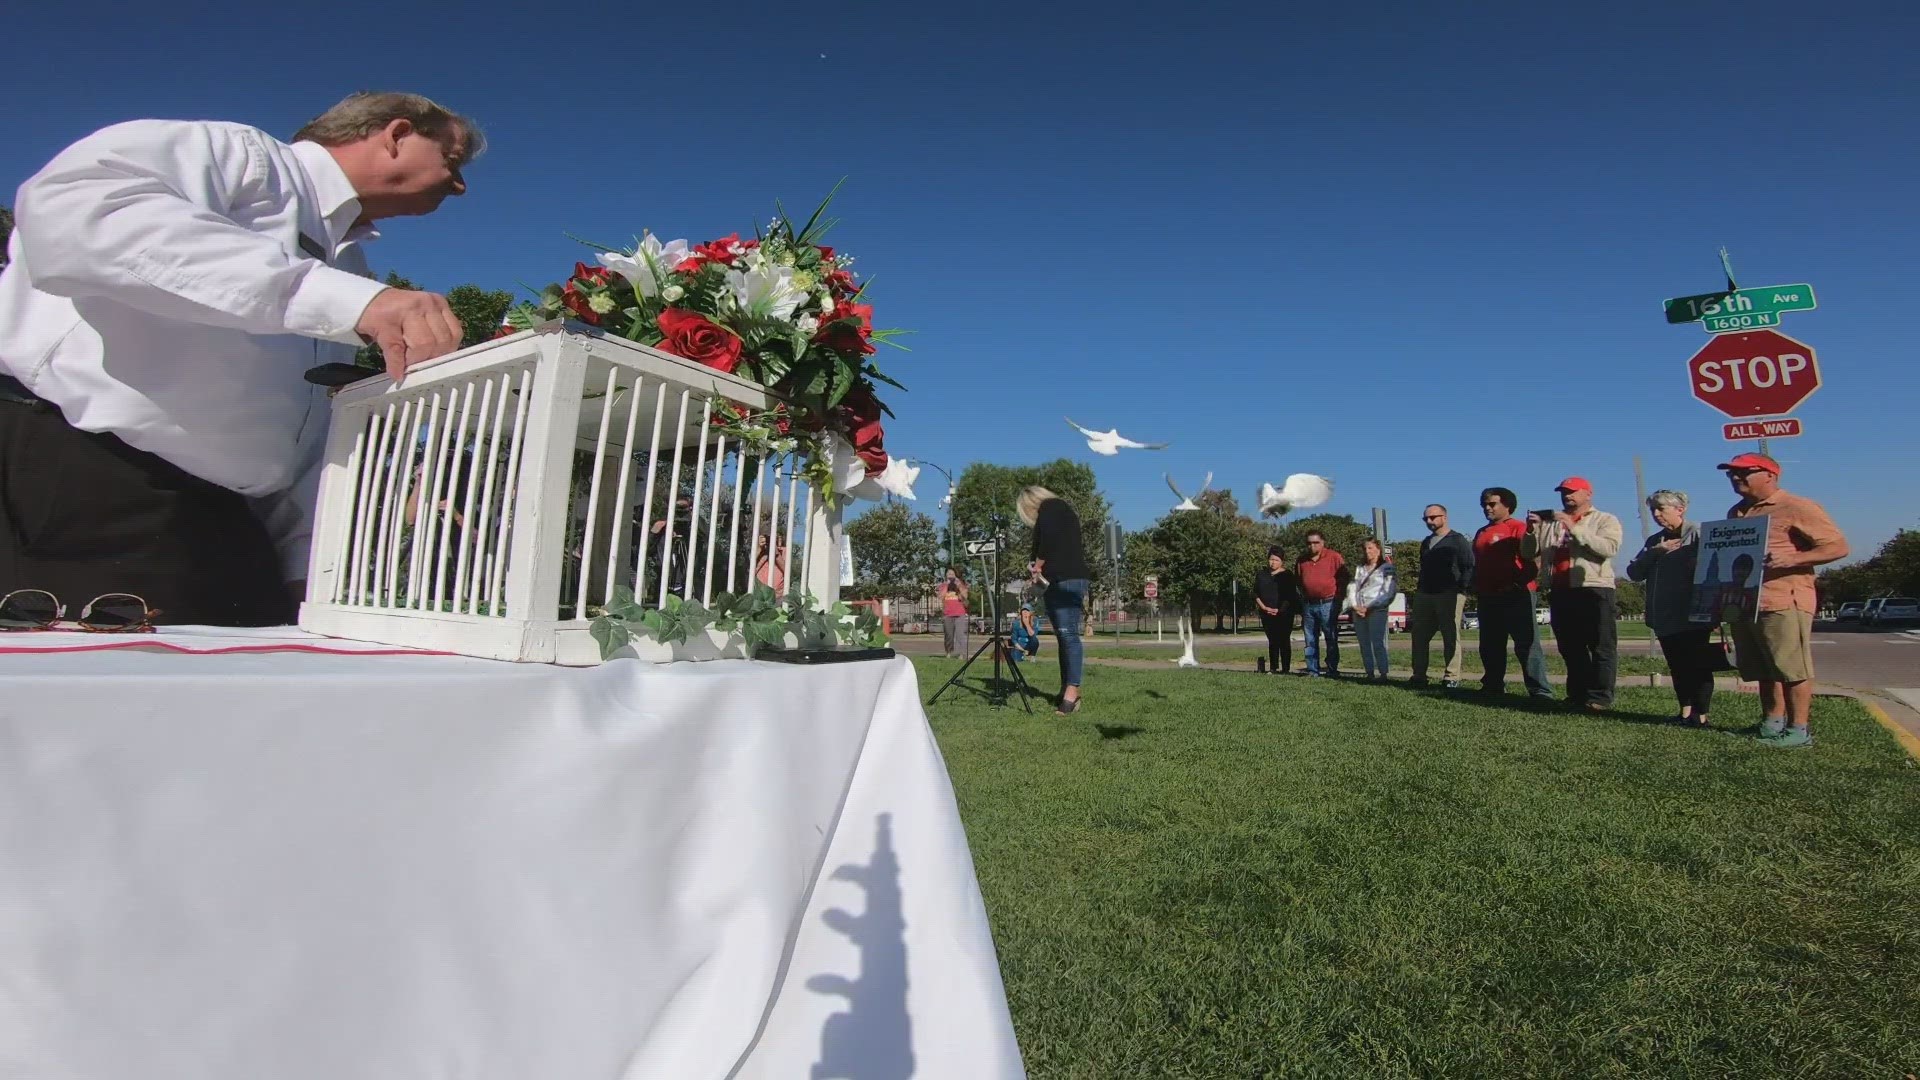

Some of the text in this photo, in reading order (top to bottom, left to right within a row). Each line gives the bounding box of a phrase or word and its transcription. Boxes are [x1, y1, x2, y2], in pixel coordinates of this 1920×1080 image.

[1687, 293, 1799, 316] 16th Ave
[1714, 314, 1770, 328] 1600 N
[1698, 353, 1806, 392] STOP
[1731, 422, 1793, 437] ALL WAY
[1704, 534, 1759, 551] respuestas!
